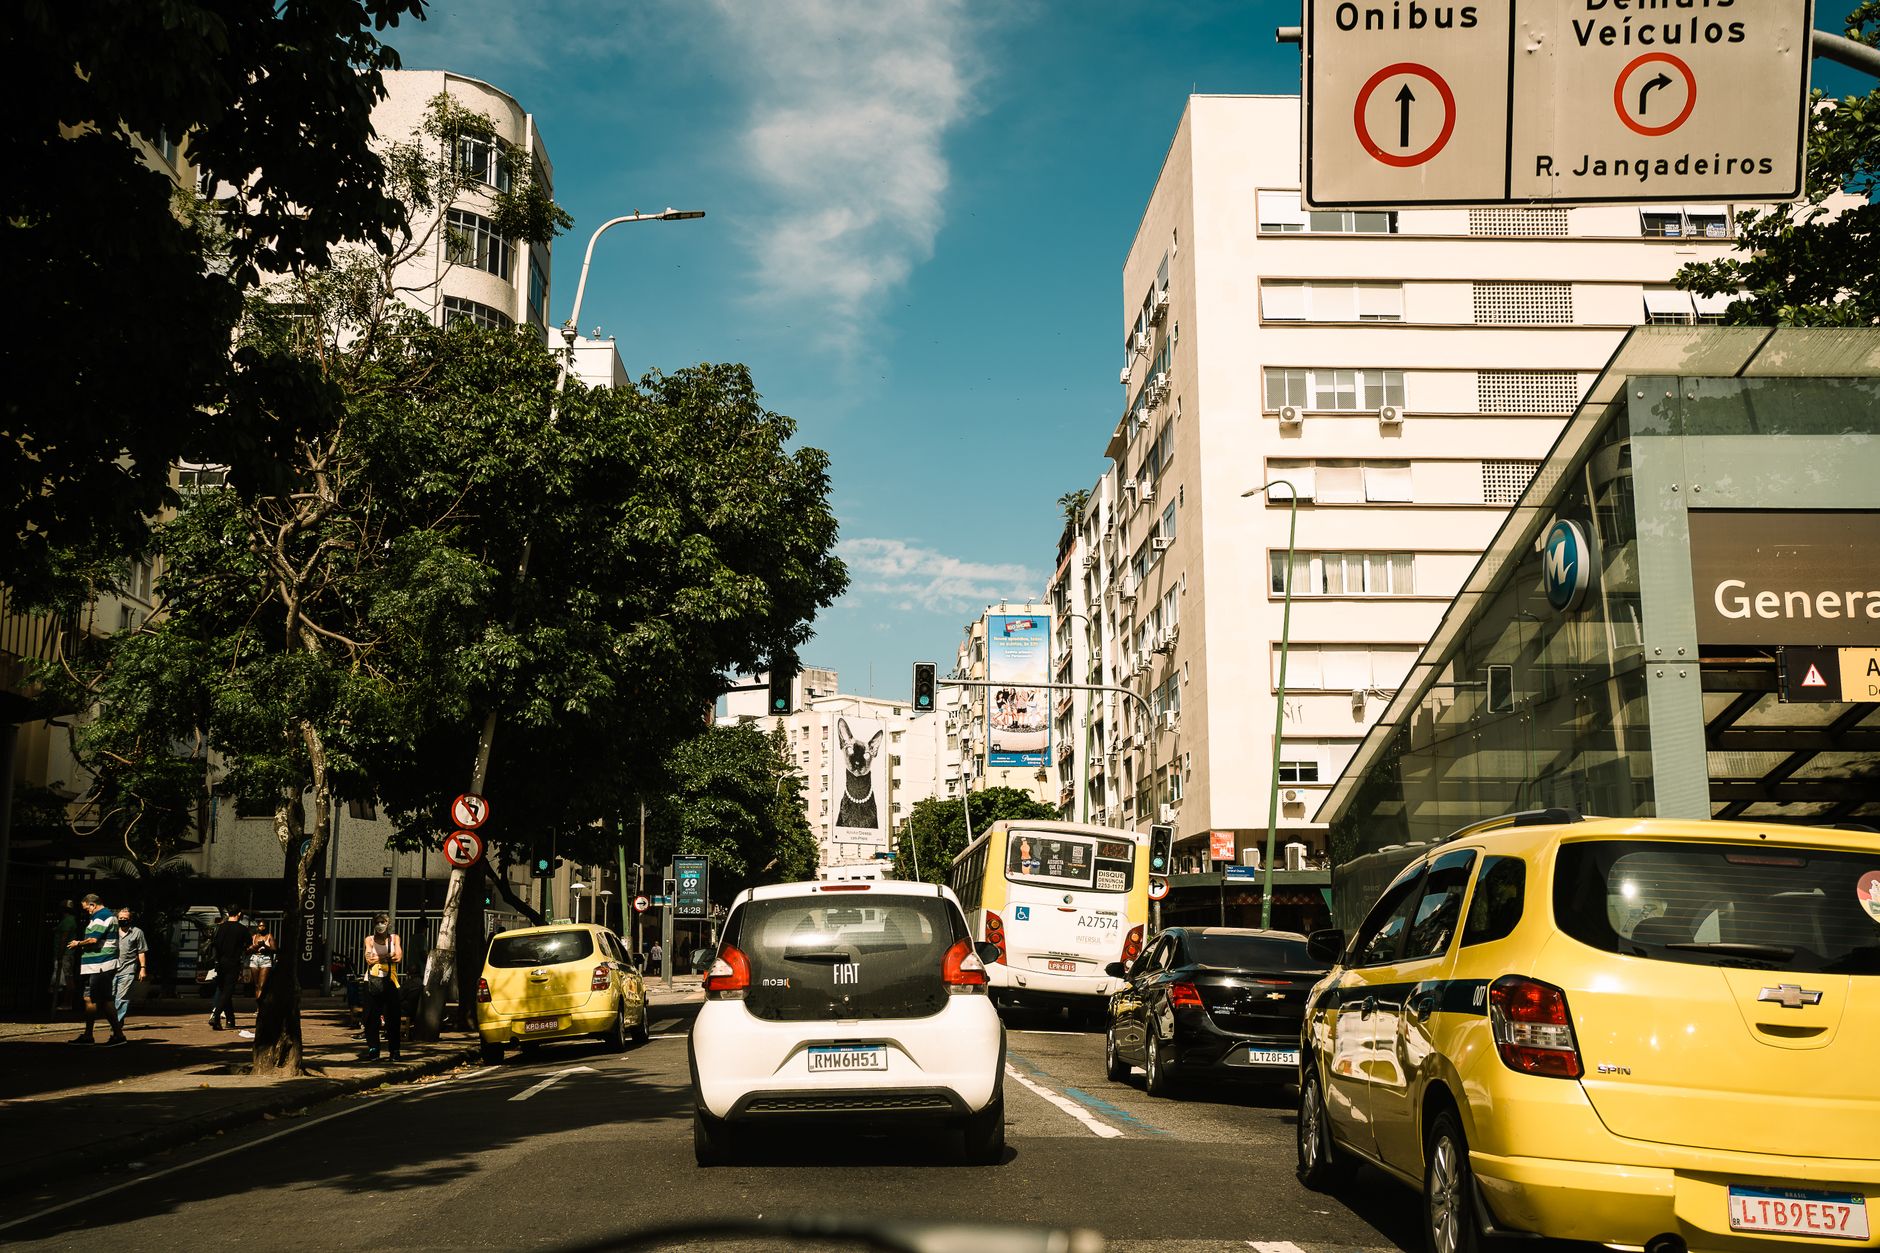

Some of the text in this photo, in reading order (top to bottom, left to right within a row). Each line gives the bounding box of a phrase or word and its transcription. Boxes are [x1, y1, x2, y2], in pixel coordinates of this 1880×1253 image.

[1571, 16, 1746, 46] Veículos
[1535, 153, 1774, 183] R. Jangadeiros
[1098, 871, 1125, 879] DISQUE
[682, 878, 698, 888] 69
[678, 906, 701, 914] 14:28
[1077, 915, 1119, 930] A27574
[302, 913, 315, 961] General
[833, 962, 860, 985] FIAT
[814, 1052, 878, 1069] RMW6H51
[1253, 1052, 1294, 1063] LTZ8F51
[1597, 1063, 1631, 1075] SPIN
[1784, 1191, 1807, 1199] BRASIL
[1741, 1199, 1851, 1231] LTB9E57
